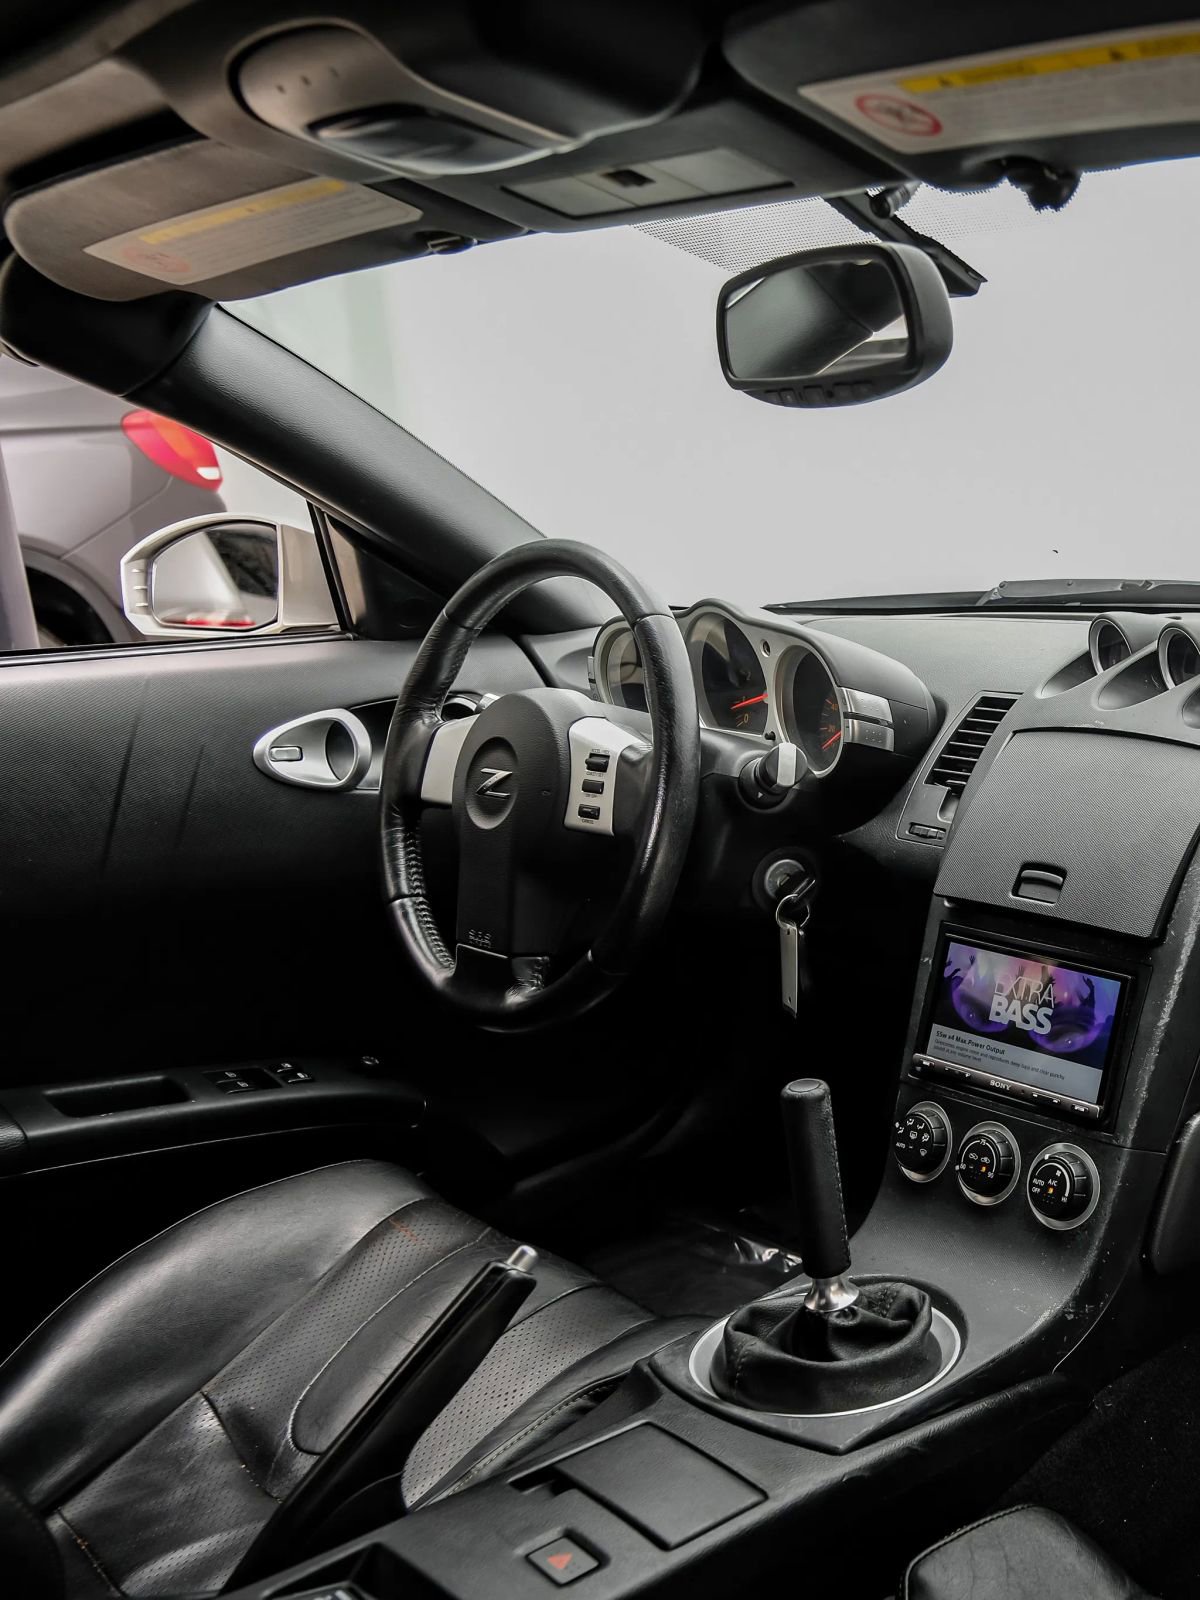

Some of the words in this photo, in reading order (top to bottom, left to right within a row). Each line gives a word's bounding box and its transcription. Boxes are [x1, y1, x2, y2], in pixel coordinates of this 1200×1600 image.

[995, 976, 1055, 1008] EXTRA
[989, 994, 1054, 1035] BASS
[989, 1079, 1013, 1091] SONY
[1032, 1178, 1045, 1187] AUTO
[1047, 1178, 1058, 1187] A/C
